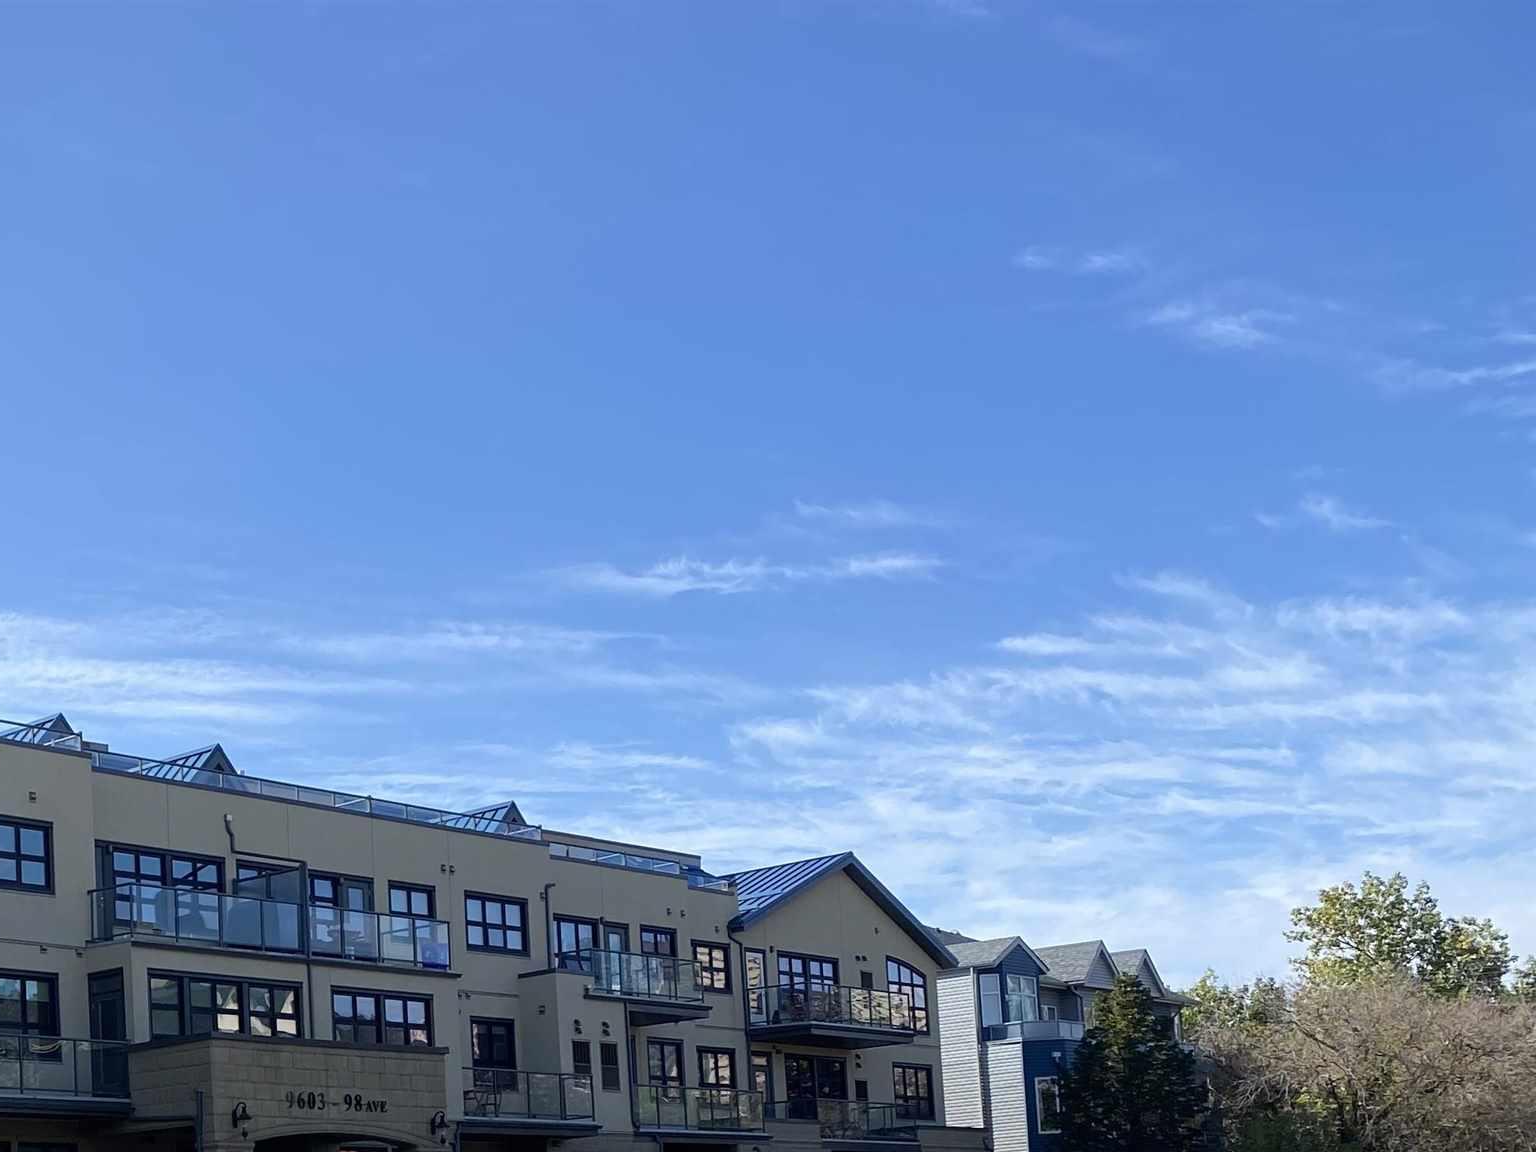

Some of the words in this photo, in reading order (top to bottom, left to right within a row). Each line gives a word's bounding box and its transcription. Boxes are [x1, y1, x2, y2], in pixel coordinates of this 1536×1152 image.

[286, 1091, 325, 1110] 9603
[344, 1094, 362, 1112] 98
[365, 1100, 388, 1113] AVE
